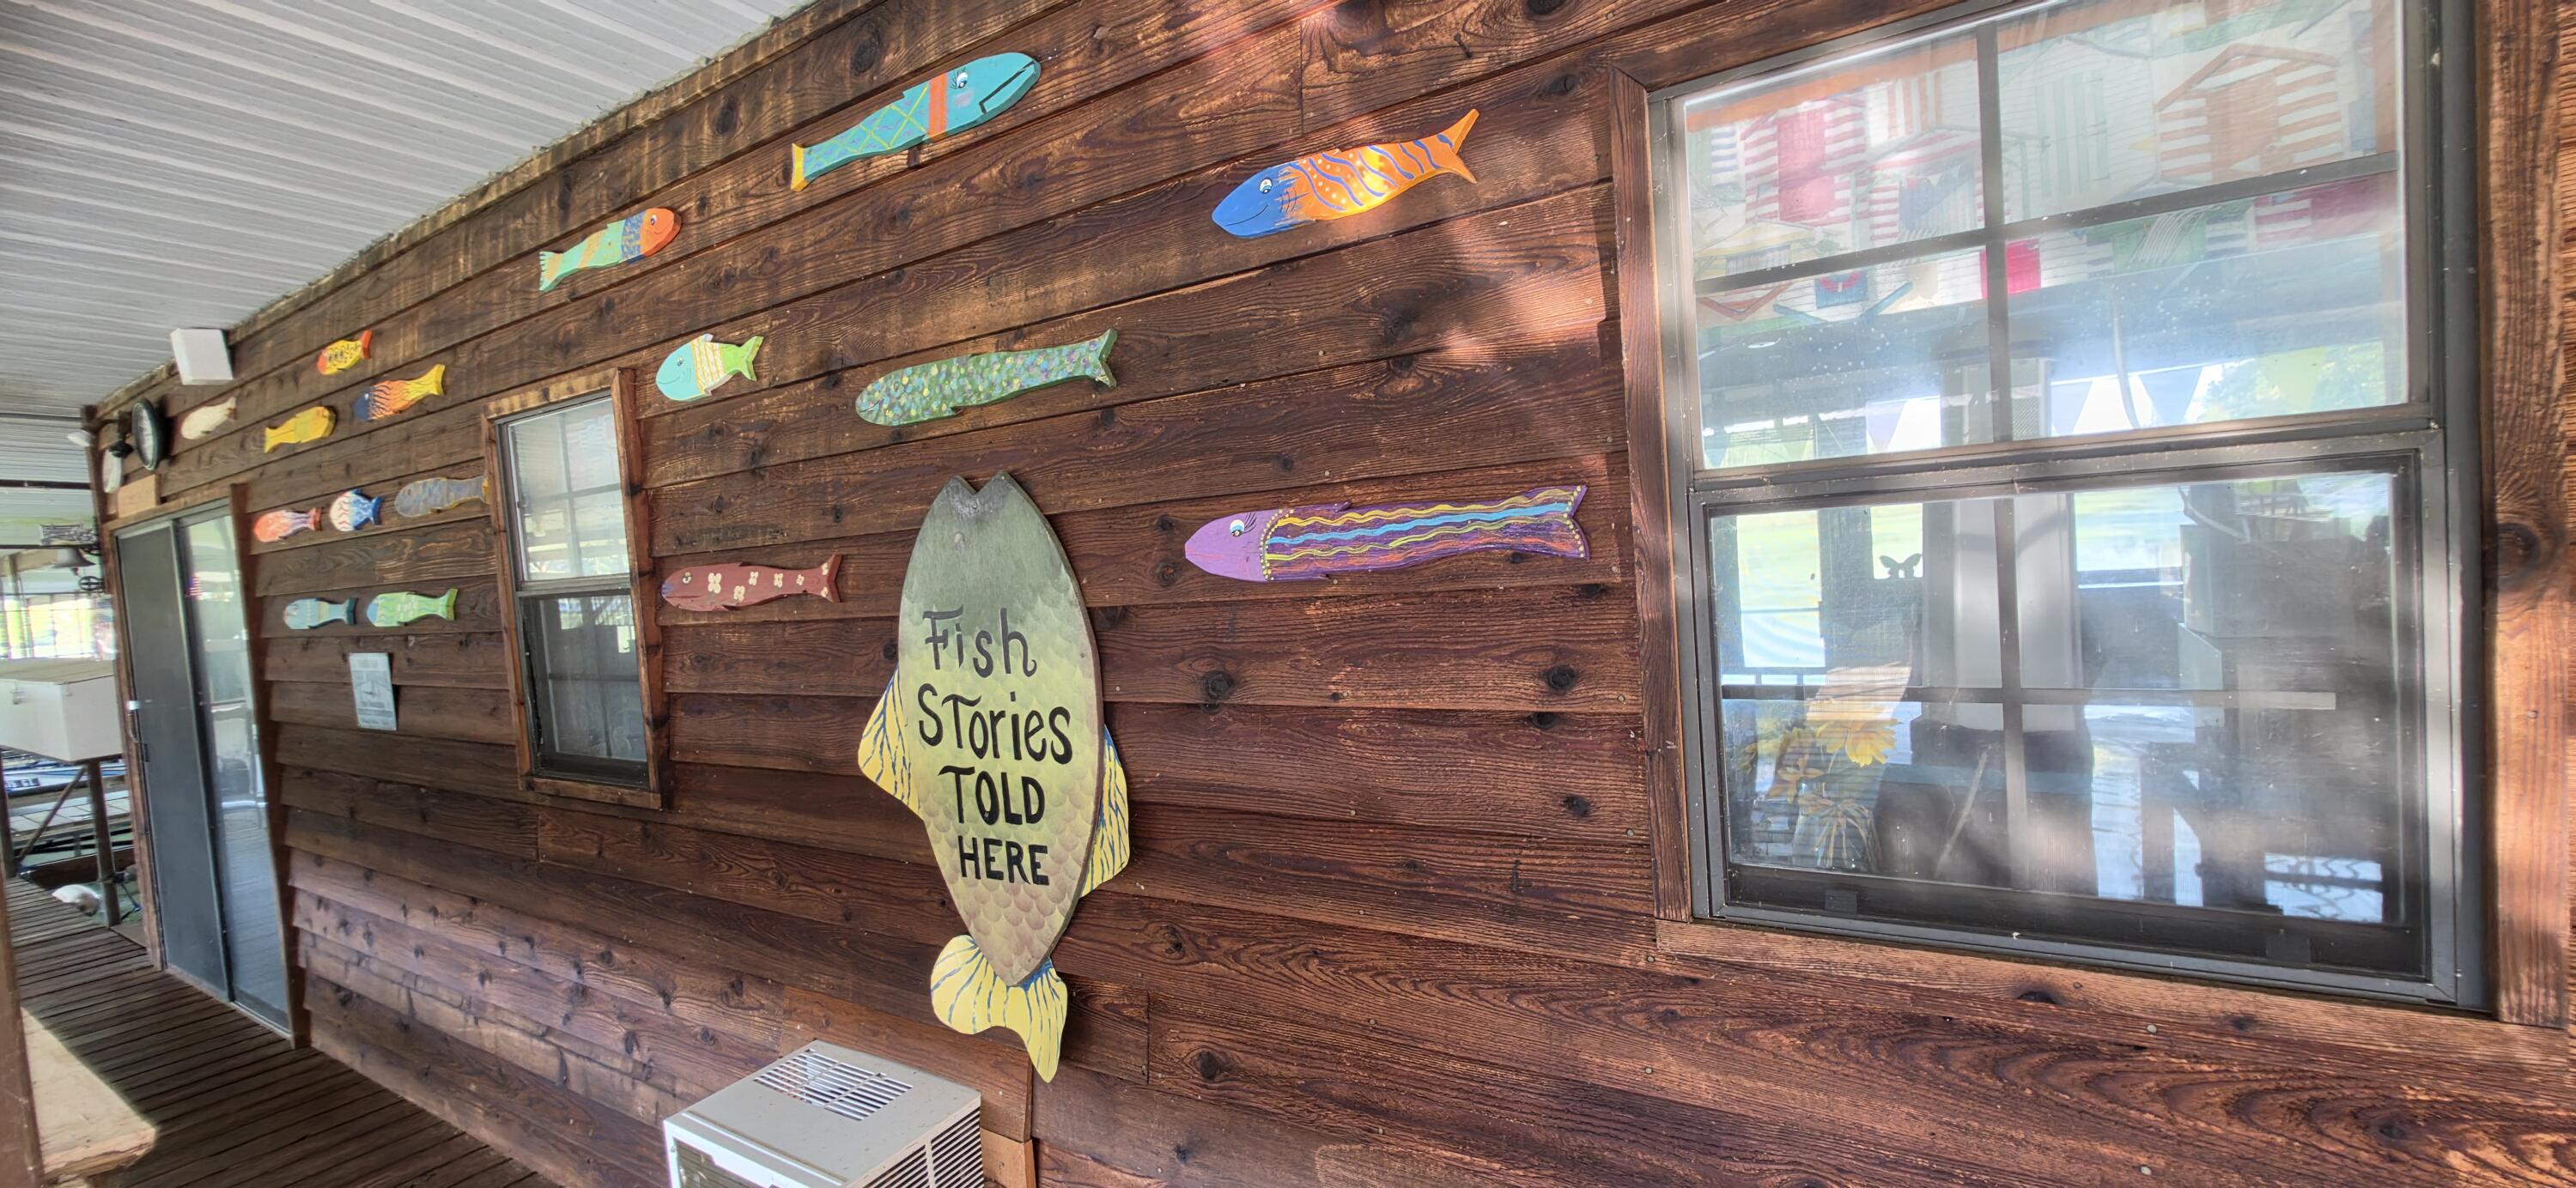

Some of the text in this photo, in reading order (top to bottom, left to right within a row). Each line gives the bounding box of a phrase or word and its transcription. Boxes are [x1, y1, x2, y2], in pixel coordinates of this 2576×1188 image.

[923, 604, 1037, 677] Fish
[938, 766, 1045, 826] TOLD
[957, 835, 1049, 886] HERE
